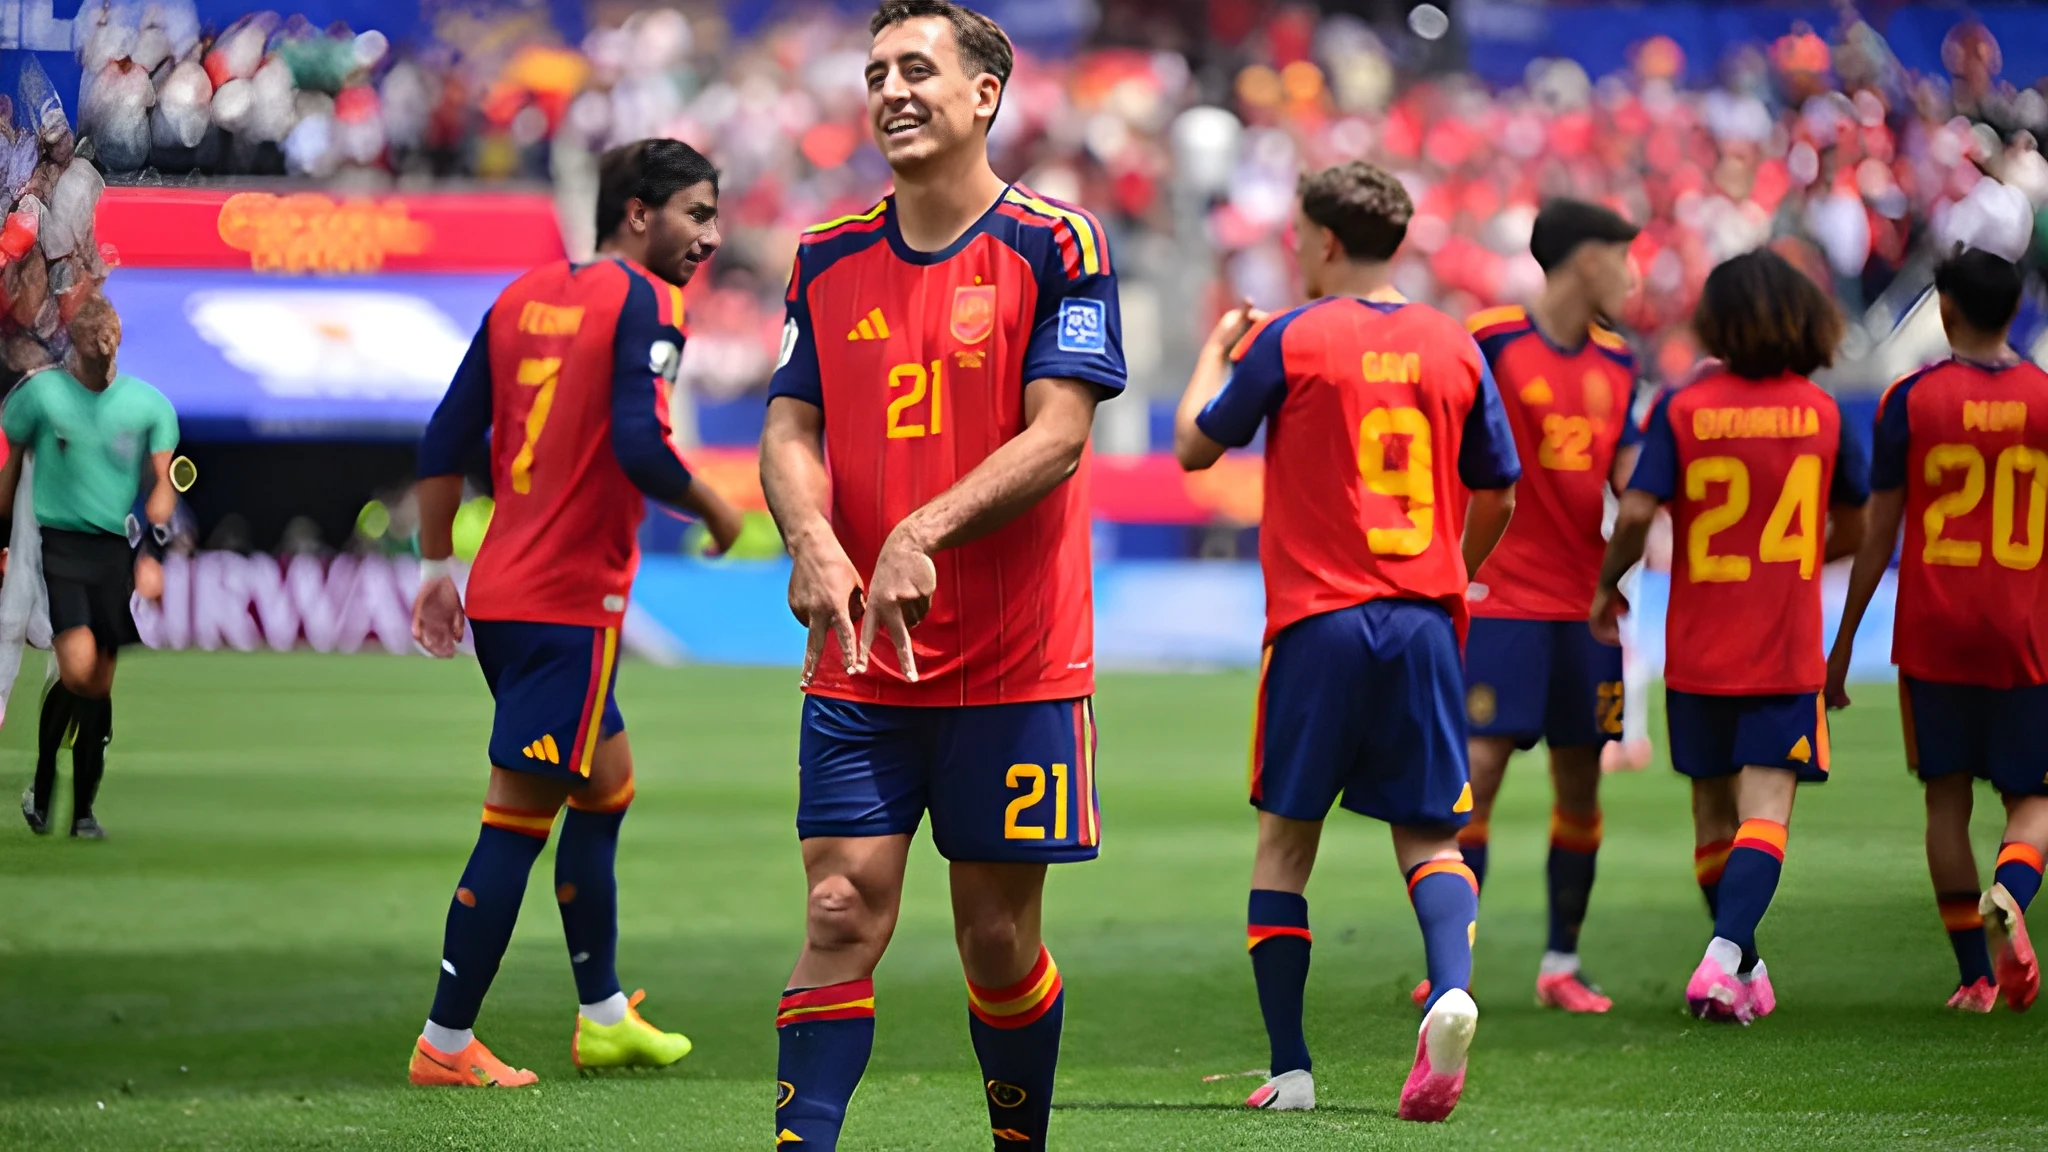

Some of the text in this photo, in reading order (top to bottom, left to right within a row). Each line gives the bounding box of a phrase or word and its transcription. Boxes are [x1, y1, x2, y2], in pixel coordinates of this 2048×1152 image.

[511, 357, 562, 495] 7
[887, 359, 942, 438] 21
[1539, 414, 1593, 472] 22
[1359, 407, 1434, 556] 9
[1686, 454, 1822, 584] 24
[1923, 443, 2048, 571] 20
[1004, 763, 1068, 840] 21
